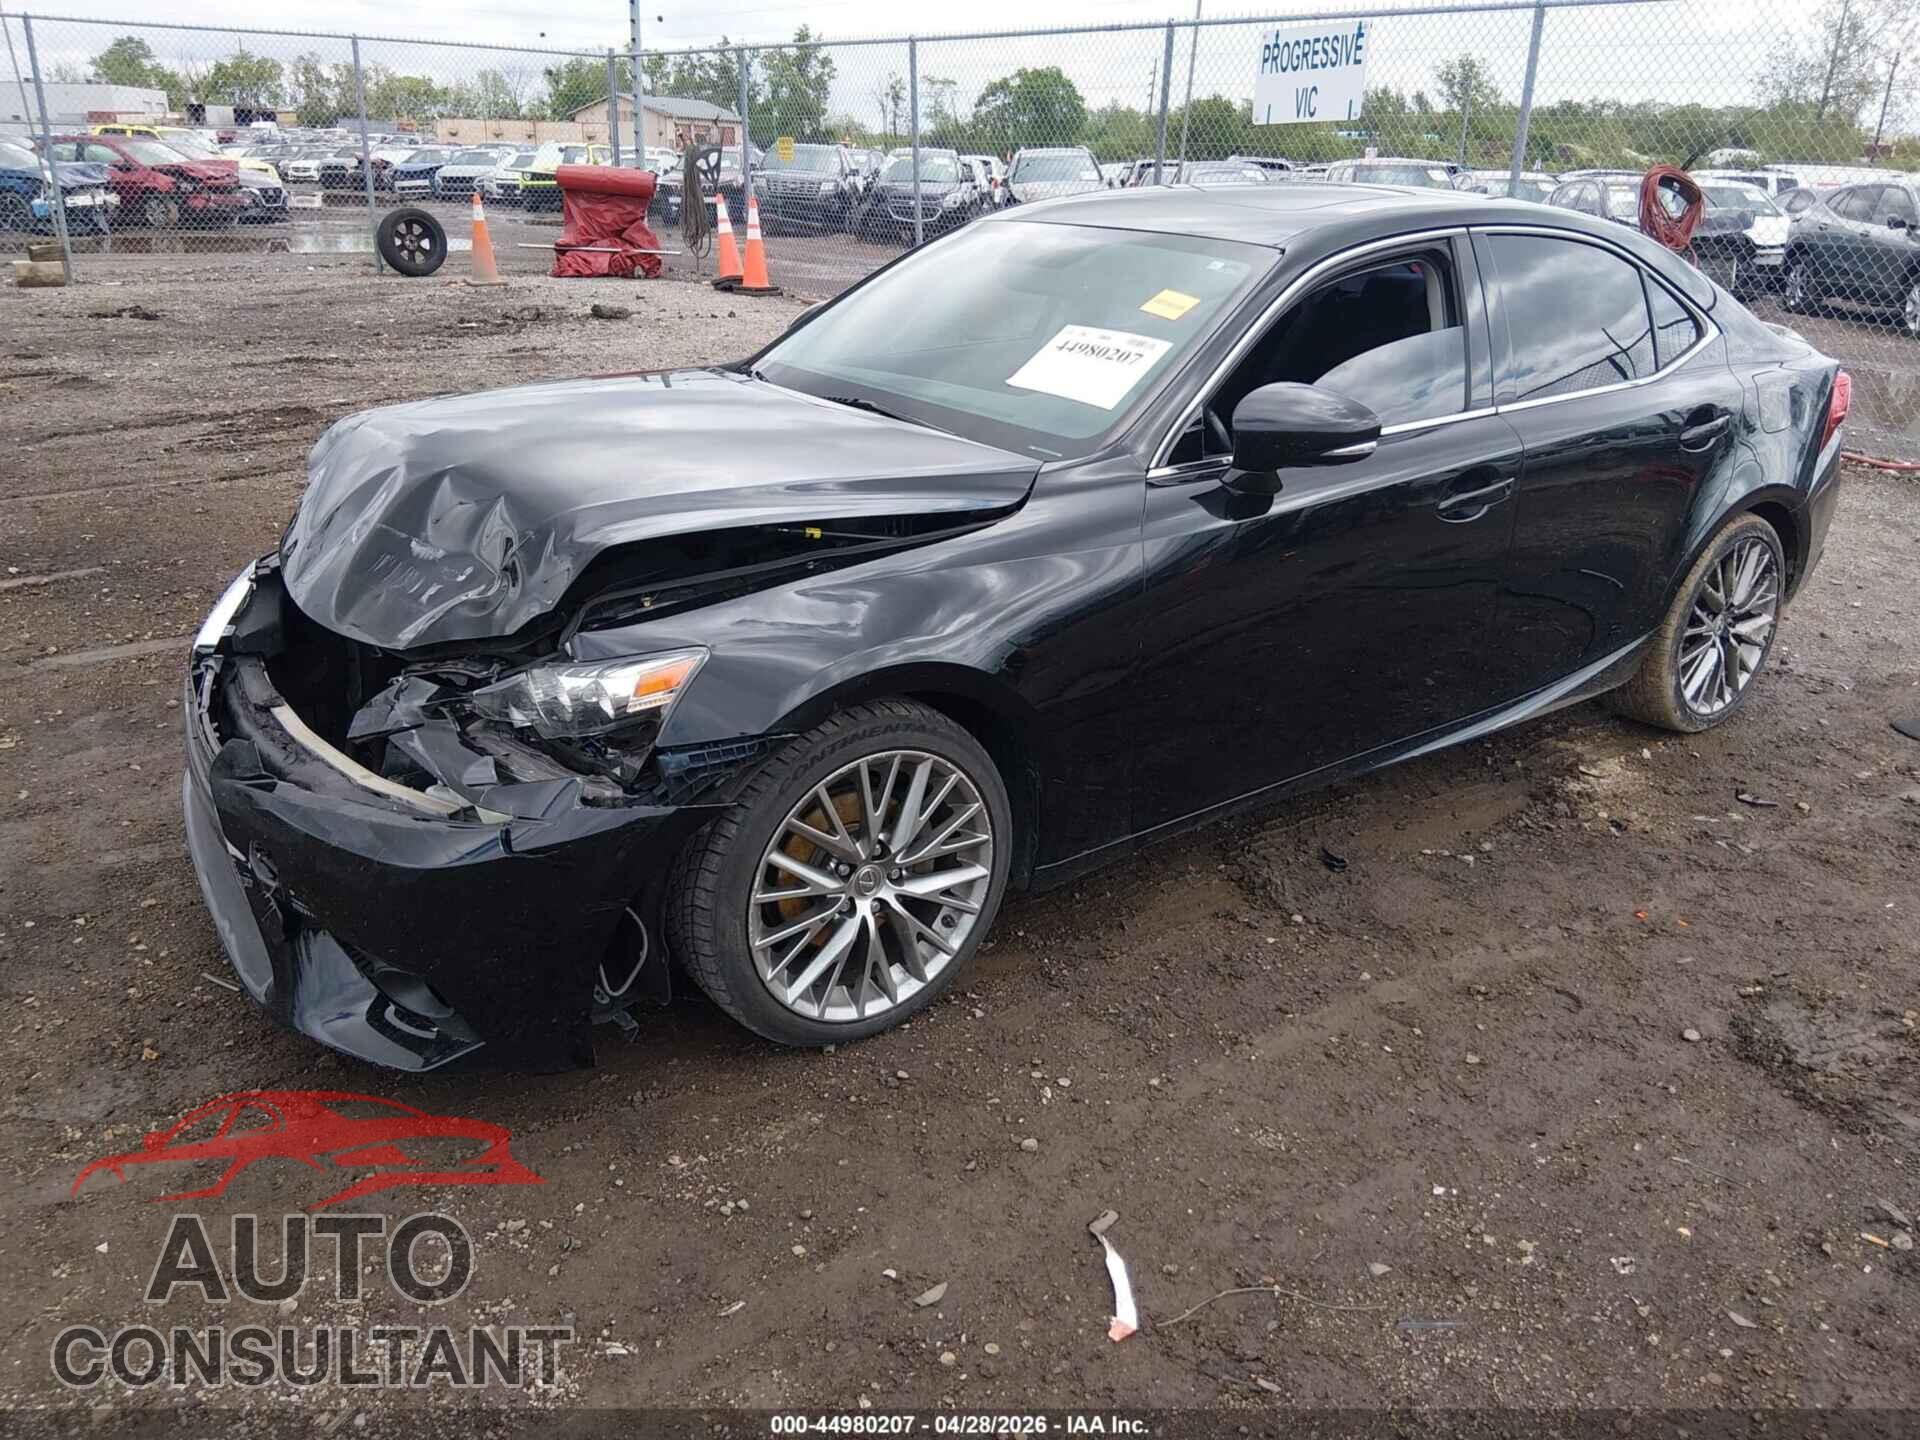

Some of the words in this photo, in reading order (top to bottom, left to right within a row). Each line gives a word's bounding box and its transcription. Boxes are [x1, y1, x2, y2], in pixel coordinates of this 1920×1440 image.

[1261, 31, 1365, 74] PROGRESSIVE
[1295, 85, 1319, 119] VIC
[1056, 339, 1145, 366] 44980207
